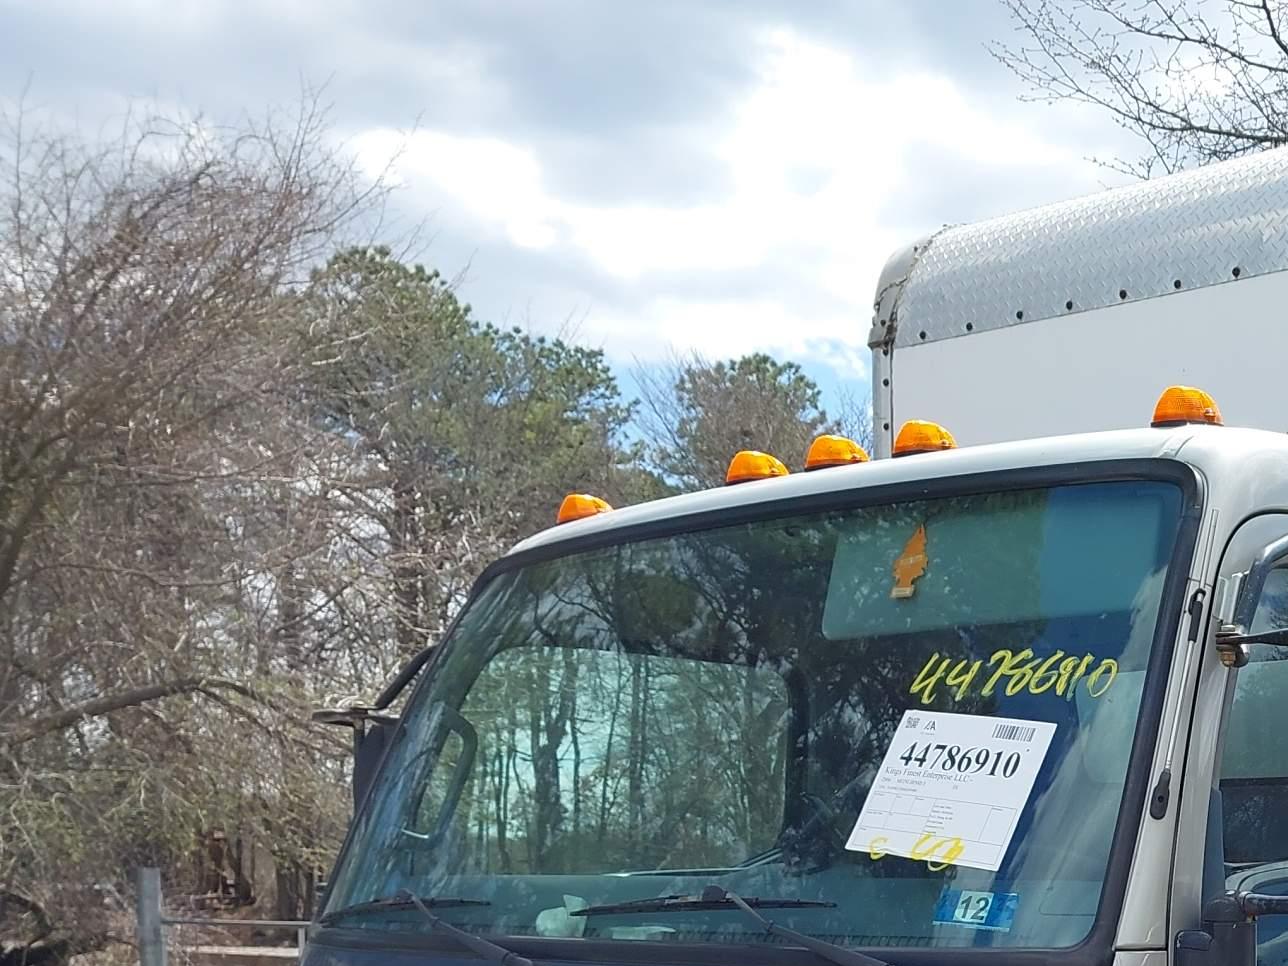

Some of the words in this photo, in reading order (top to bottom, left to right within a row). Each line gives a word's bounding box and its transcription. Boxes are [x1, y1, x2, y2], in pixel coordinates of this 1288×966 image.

[909, 648, 1119, 705] 44786910
[899, 741, 1021, 779] 44786910
[960, 895, 989, 921] 12
